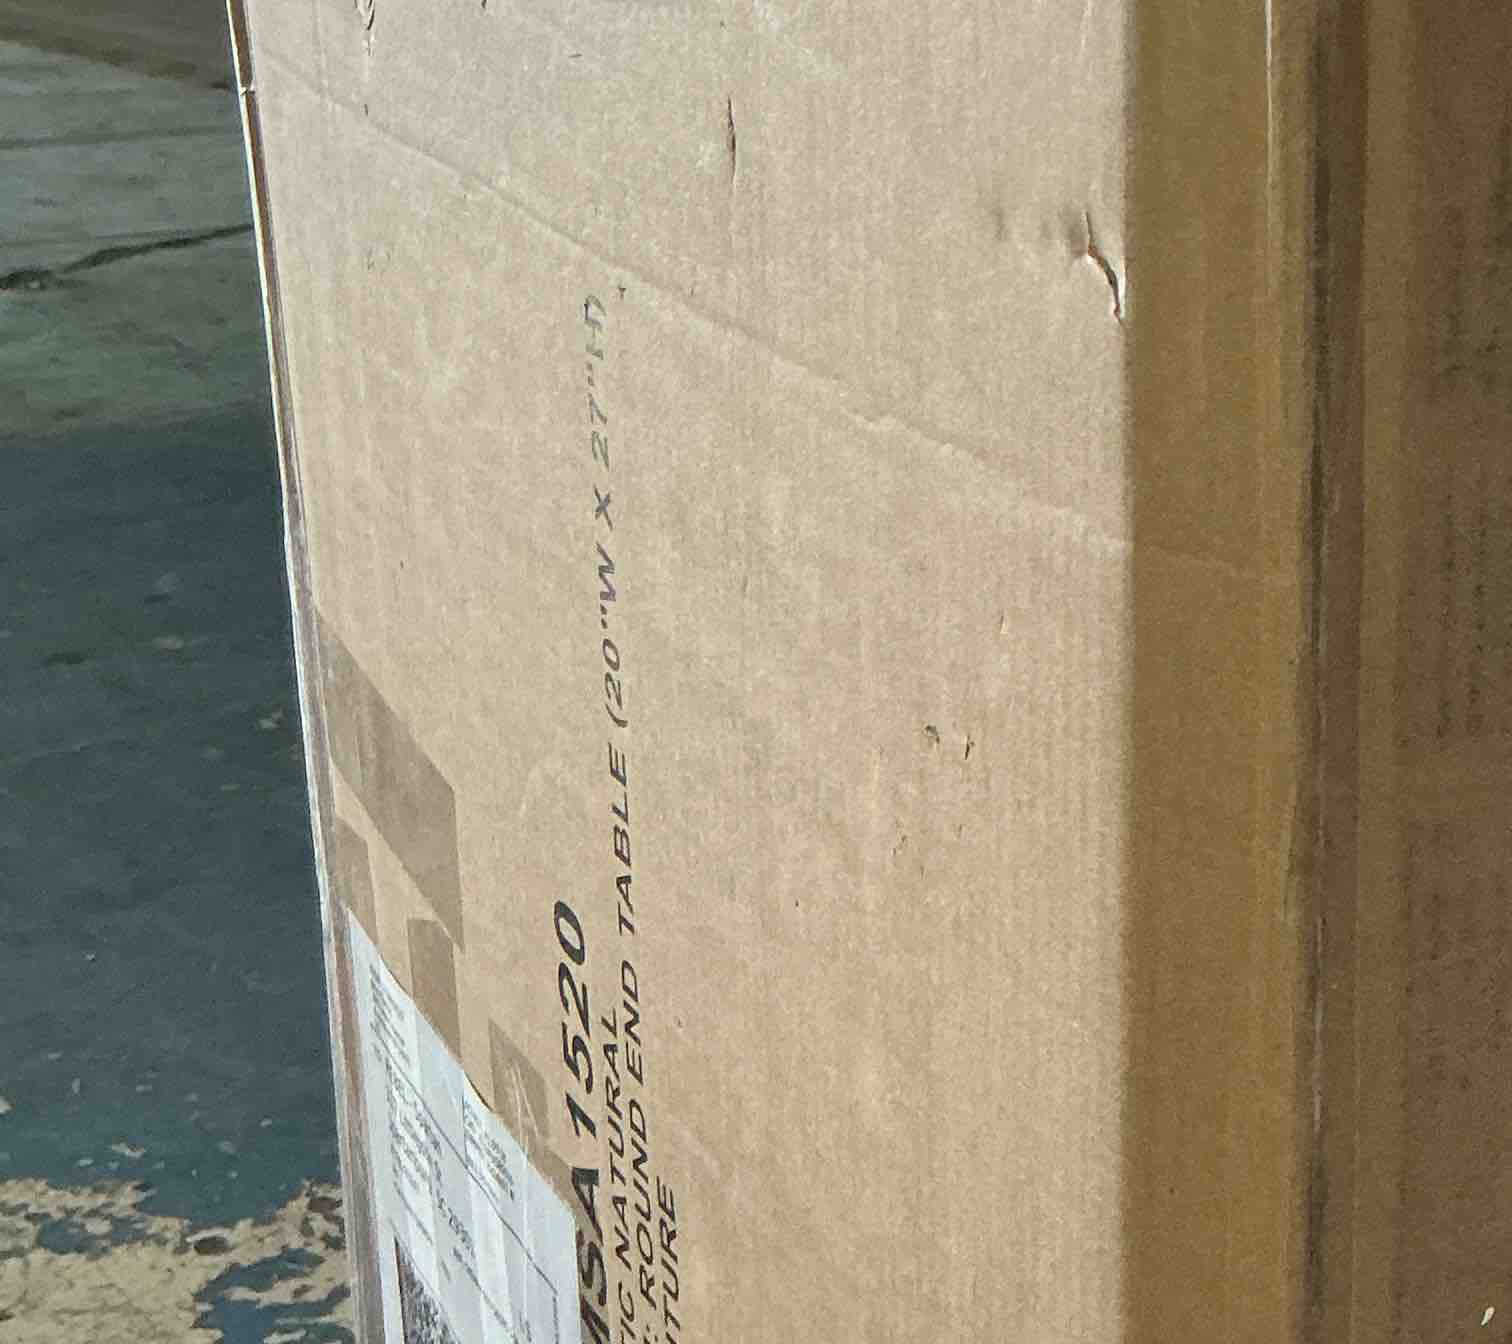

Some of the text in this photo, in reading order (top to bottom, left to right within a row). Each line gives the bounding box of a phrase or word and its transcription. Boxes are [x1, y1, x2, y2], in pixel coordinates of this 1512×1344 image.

[594, 484, 613, 530] X
[596, 541, 628, 728] (20"W
[608, 741, 635, 936] TABLE
[621, 959, 644, 1086] END
[601, 1007, 632, 1271] NATURAL
[629, 1098, 657, 1310] ROUND
